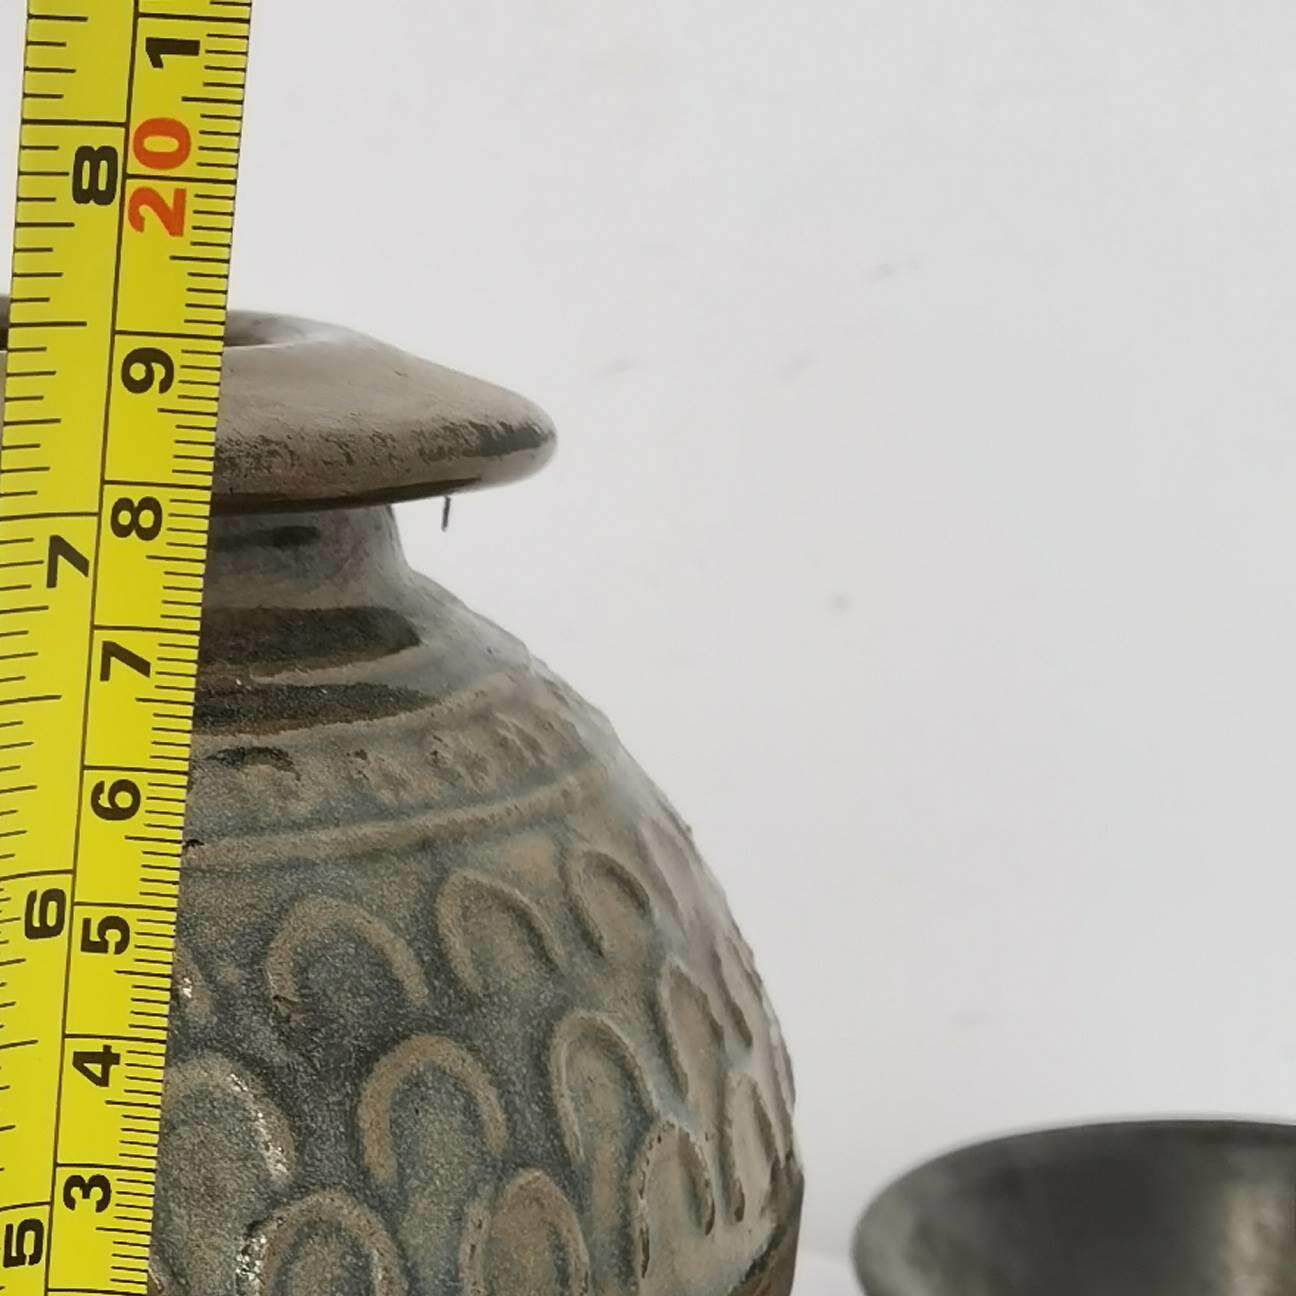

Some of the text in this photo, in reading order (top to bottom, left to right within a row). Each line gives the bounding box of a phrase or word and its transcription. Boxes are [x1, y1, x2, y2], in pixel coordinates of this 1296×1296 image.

[145, 37, 200, 68] 1
[72, 145, 118, 205] 8
[127, 117, 192, 237] 20
[121, 347, 175, 394] 9
[111, 496, 163, 541] 8
[46, 535, 90, 588] 7
[100, 640, 151, 681] 7
[90, 779, 141, 821] 6
[24, 888, 67, 940] 6
[80, 915, 130, 955] 5
[72, 1045, 121, 1087] 4
[63, 1174, 112, 1213] 3
[3, 1218, 44, 1268] 5
